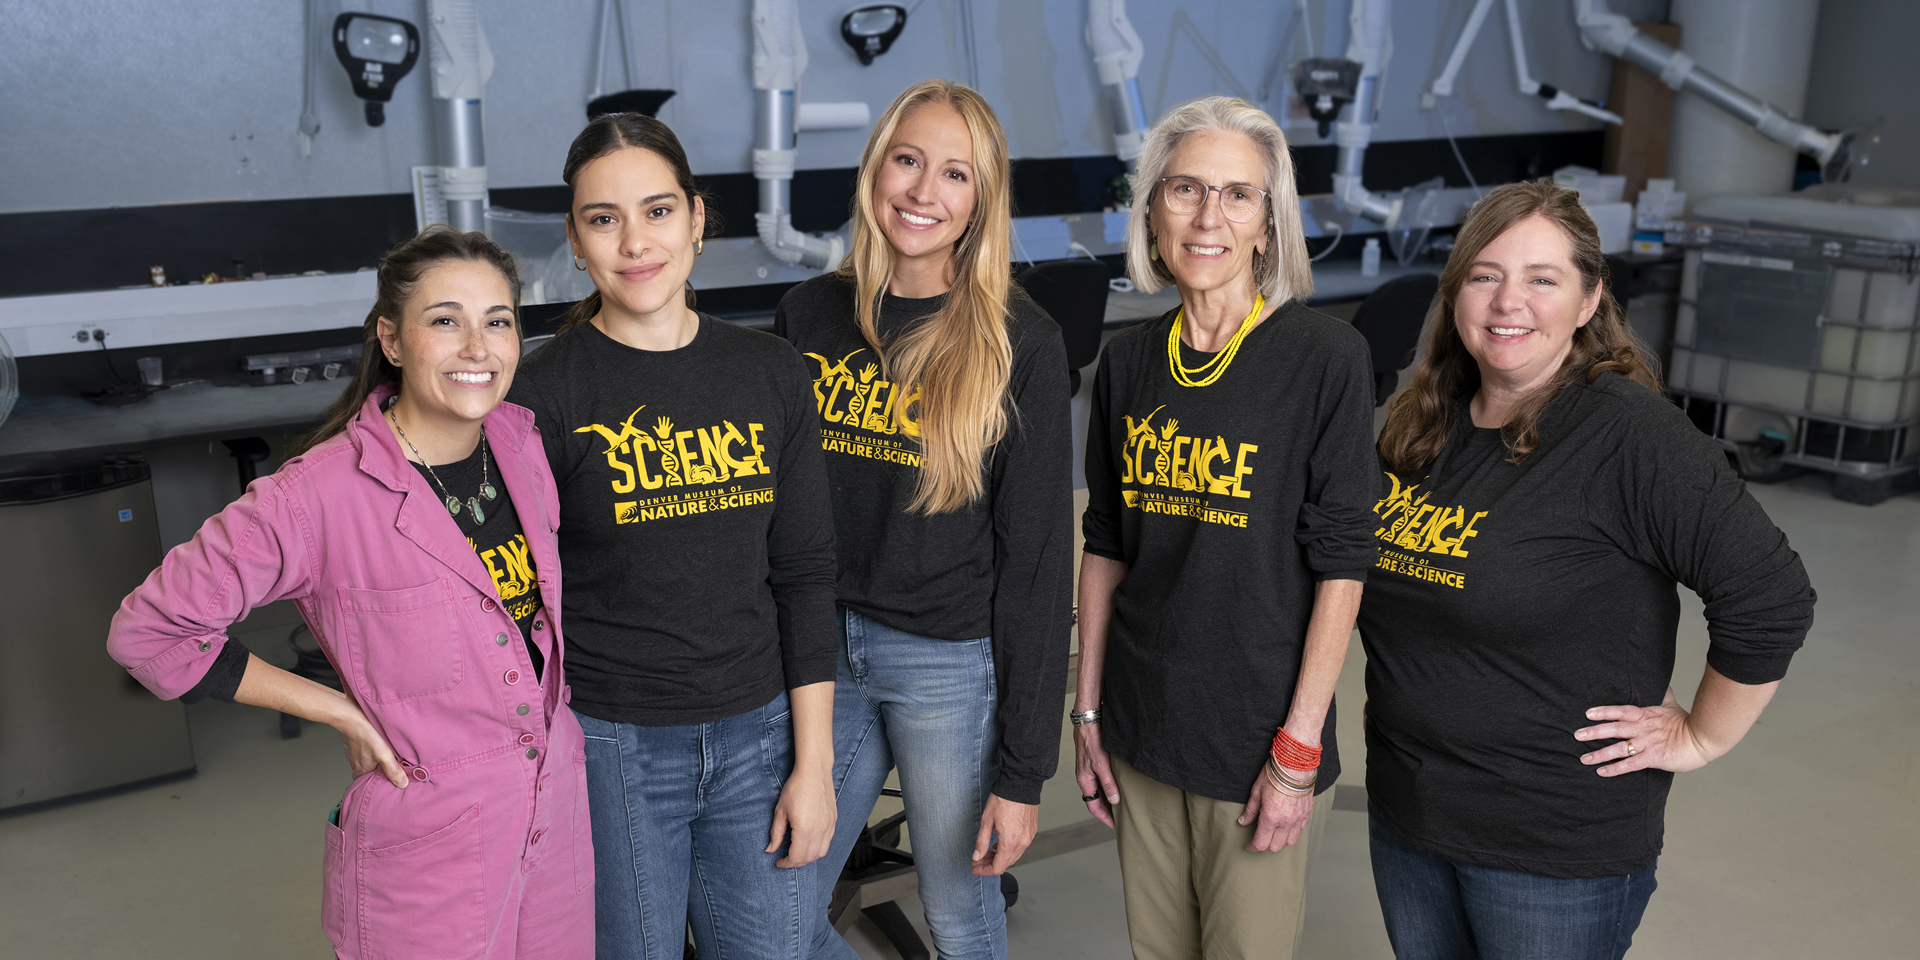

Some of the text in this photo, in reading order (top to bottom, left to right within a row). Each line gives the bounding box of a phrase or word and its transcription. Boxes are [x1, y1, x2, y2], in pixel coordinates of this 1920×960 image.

[855, 435, 889, 446] MUSEUM
[893, 441, 902, 449] OF
[606, 416, 771, 494] SCIENCE
[821, 438, 928, 469] NATURE&SCIENC
[639, 485, 743, 507] DENVER MUSEUM OF
[640, 489, 774, 522] NATURE&SCIENCE
[1168, 495, 1200, 504] MUSEUM
[1384, 550, 1429, 566] MUSEUM OF
